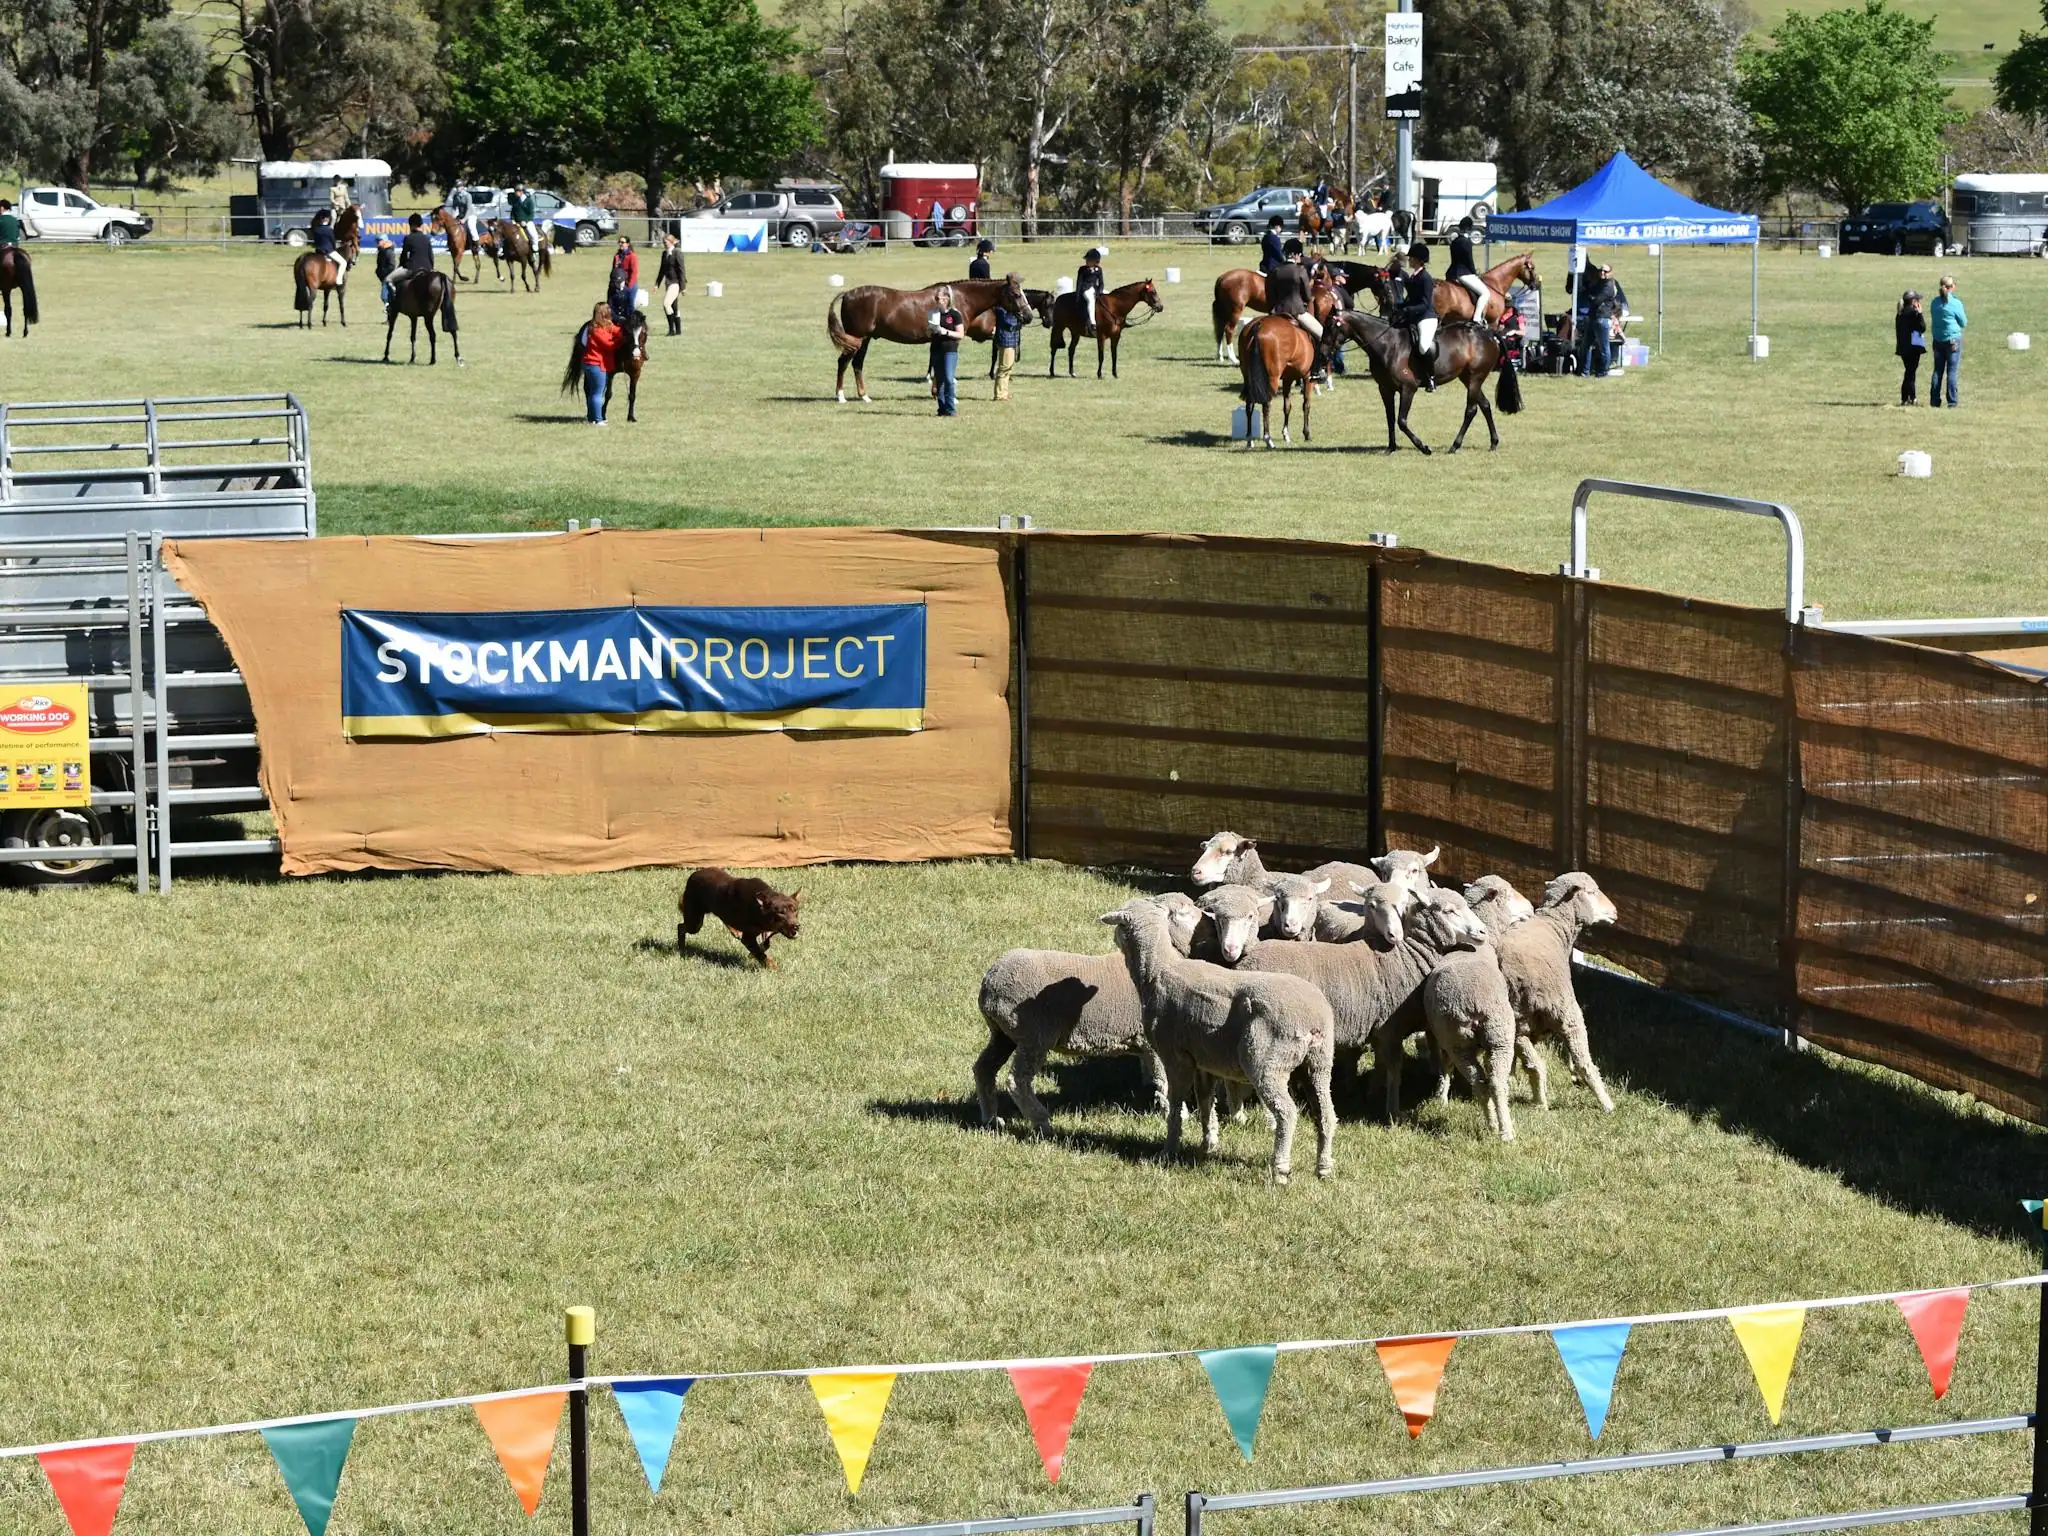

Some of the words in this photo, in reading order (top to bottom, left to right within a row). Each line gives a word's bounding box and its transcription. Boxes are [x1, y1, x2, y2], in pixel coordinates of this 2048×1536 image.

[1388, 34, 1419, 47] Bakery
[1393, 61, 1414, 71] Cafe
[1489, 224, 1509, 234] OMEO
[1511, 224, 1517, 233] &
[1517, 224, 1549, 236] DISTRICT
[1550, 225, 1573, 237] SHOW
[1585, 226, 1625, 238] OMEO
[1628, 226, 1640, 238] &
[1643, 225, 1705, 238] DISTRICT
[1708, 224, 1750, 236] SHOW
[0, 713, 47, 721] WORKING
[48, 712, 70, 720] DOG
